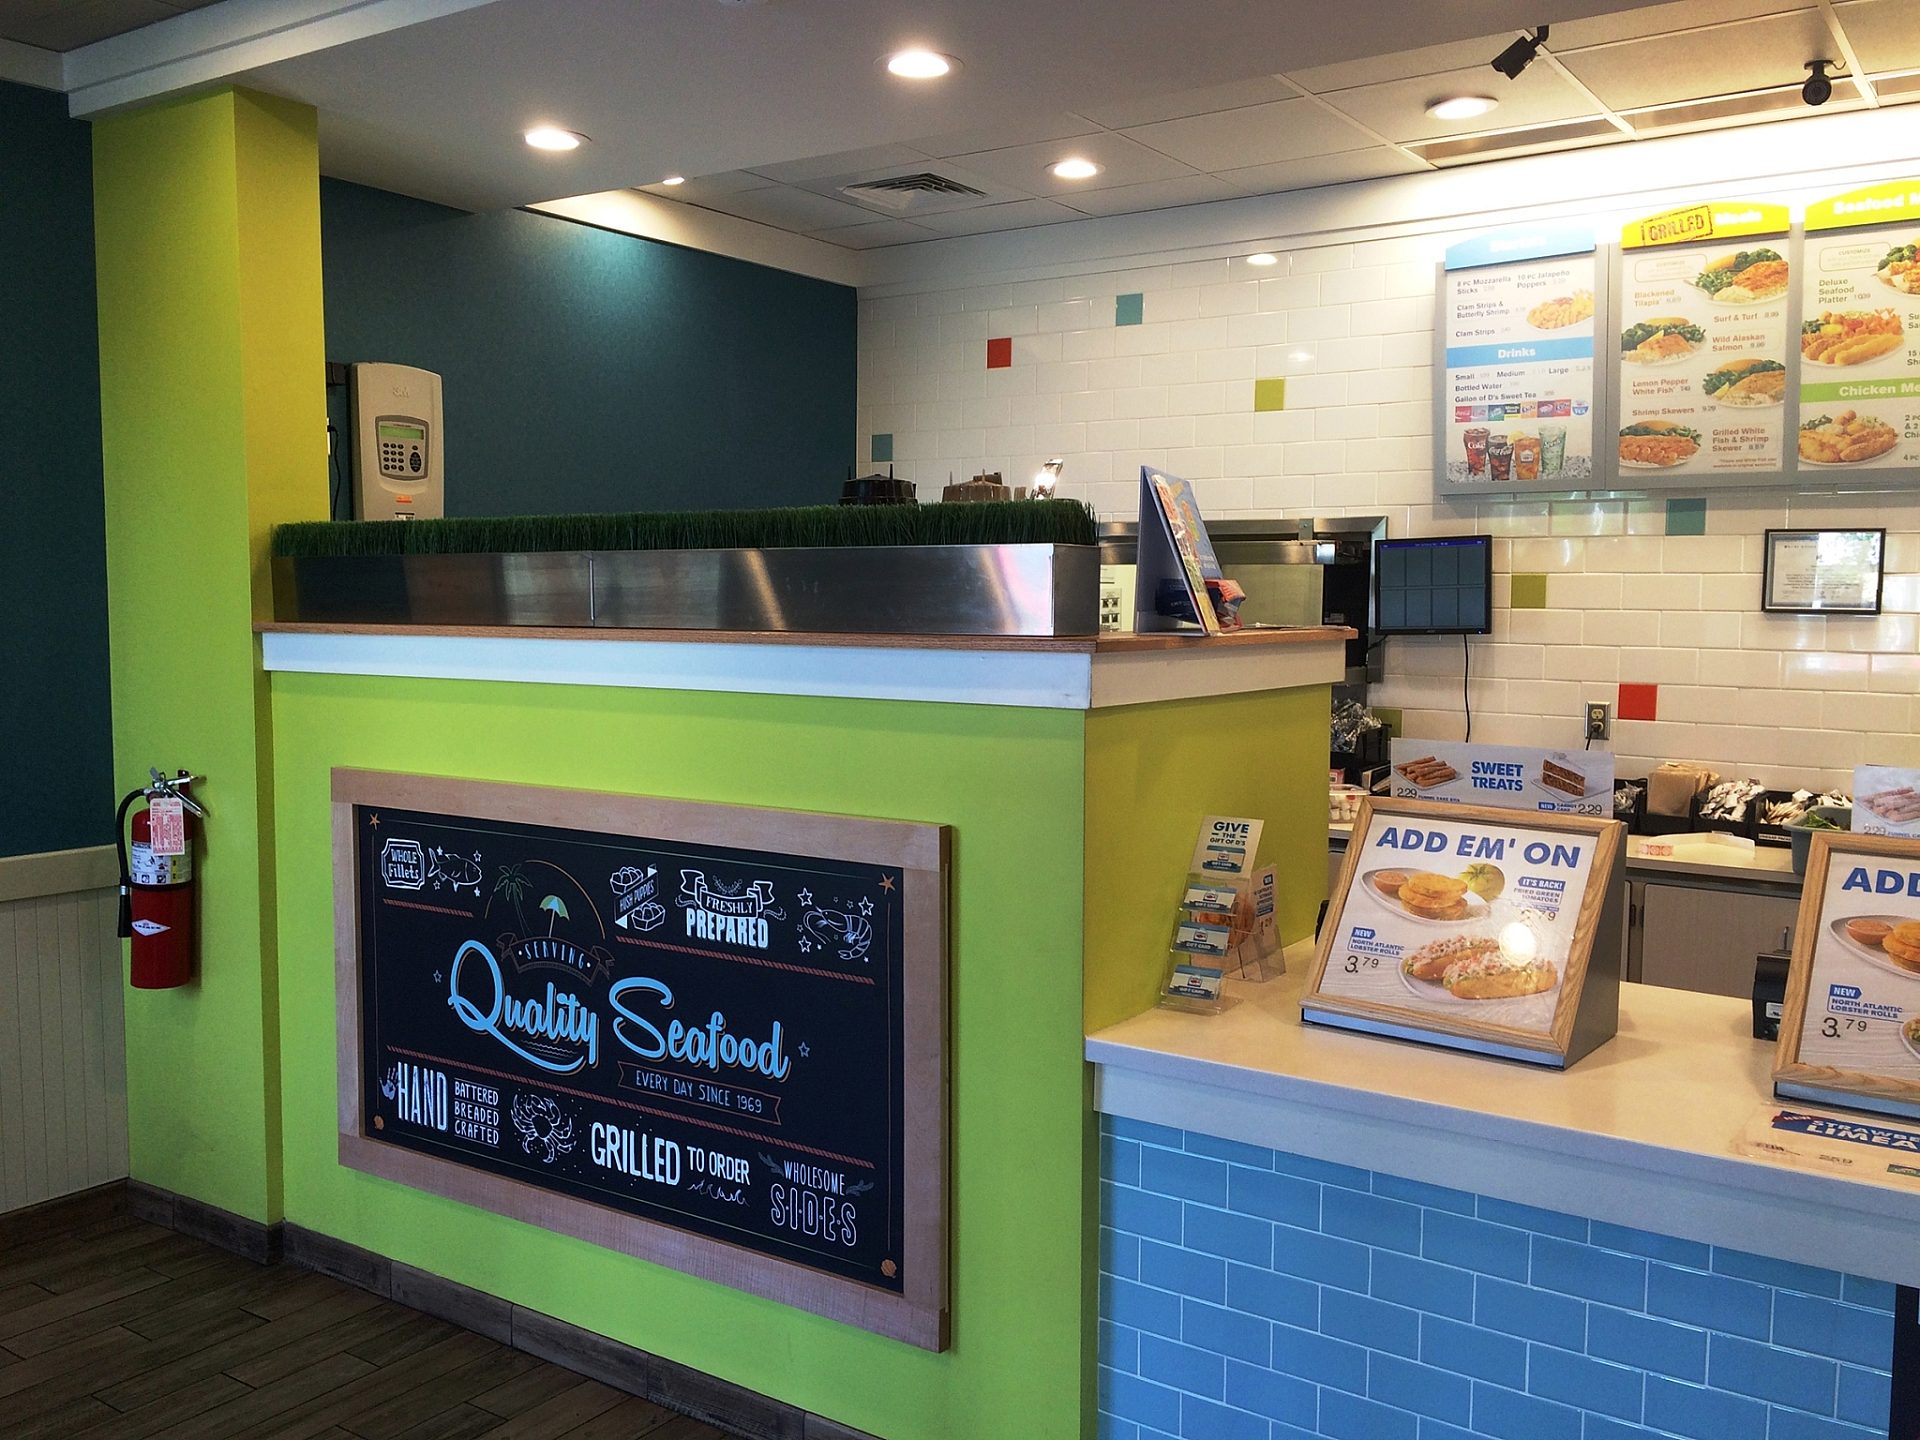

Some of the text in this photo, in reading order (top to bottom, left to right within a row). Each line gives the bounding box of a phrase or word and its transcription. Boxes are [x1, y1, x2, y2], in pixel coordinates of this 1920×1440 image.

[1648, 213, 1705, 242] GRILLED
[1473, 276, 1512, 286] Mozzarella
[1516, 280, 1547, 289] Poppers
[1818, 278, 1849, 287] Deluxe
[1818, 286, 1855, 296] Seafood
[1456, 303, 1475, 311] Clam
[1476, 301, 1497, 310] Strips
[1818, 295, 1848, 304] Platter
[1456, 310, 1485, 319] Butterfly
[1713, 314, 1732, 323] Surf
[1733, 313, 1740, 321] &
[1741, 312, 1758, 321] Turf
[1455, 330, 1474, 338] Clam
[1474, 328, 1496, 336] Strips
[1712, 333, 1766, 344] Wild Alaskan
[1497, 347, 1537, 359] Drinks
[1712, 343, 1743, 352] Salmon
[1455, 373, 1476, 381] Small
[1496, 370, 1526, 379] Medium
[1548, 367, 1570, 375] Large
[1454, 383, 1481, 392] Bottled
[1481, 382, 1503, 390] Water
[1632, 378, 1689, 388] Lemon Pepper
[1454, 395, 1478, 403] Gallon
[1487, 393, 1499, 401] D's
[1500, 392, 1523, 400] Sweet
[1524, 391, 1538, 399] Tea
[1632, 387, 1656, 396] White
[1839, 384, 1896, 397] Chicken
[1632, 408, 1660, 417] Shrimp
[1661, 407, 1695, 415] Skewers
[1712, 427, 1766, 436] Grilled White
[1712, 436, 1730, 444] Fish
[1739, 434, 1770, 444] Shrimp
[1712, 444, 1743, 453] Skewer
[1471, 760, 1524, 778] SWEET
[1471, 775, 1524, 792] TREATS
[1577, 803, 1603, 816] 2.29
[1213, 821, 1250, 834] GIVE
[1375, 826, 1581, 868] ADD EM' ON
[390, 848, 418, 864] WHOLE
[388, 863, 420, 881] Fillets
[1522, 878, 1563, 890] IT'S BACK!
[619, 879, 655, 913] HUSH PUPPIES
[1521, 894, 1559, 903] TOMATOES
[1535, 889, 1560, 898] GREEN
[705, 895, 754, 914] FRESHLY
[686, 907, 769, 949] PREPARED
[1354, 928, 1373, 939] NEW
[1349, 943, 1400, 956] LOBSTER ROLLS
[1351, 938, 1405, 951] NORTH ATLANTIC
[524, 940, 586, 971] SERVING
[1344, 955, 1380, 974] 3.79
[1832, 986, 1857, 998] NEW
[448, 939, 790, 1080] Quality Seafood
[1830, 1004, 1899, 1019] LOBSTER ROLLS
[1831, 998, 1904, 1014] NORTH ATLANTIC
[1821, 1016, 1868, 1038] 3.79
[397, 1061, 449, 1132] HAND
[454, 1081, 500, 1106] BATTERED
[635, 1069, 763, 1114] EVERY DAY SINCE 1969
[454, 1100, 500, 1126] BREADED
[454, 1119, 500, 1145] CRAFTED
[590, 1121, 751, 1186] GRILLED TO ORDER
[783, 1159, 846, 1196] WHOLESOME
